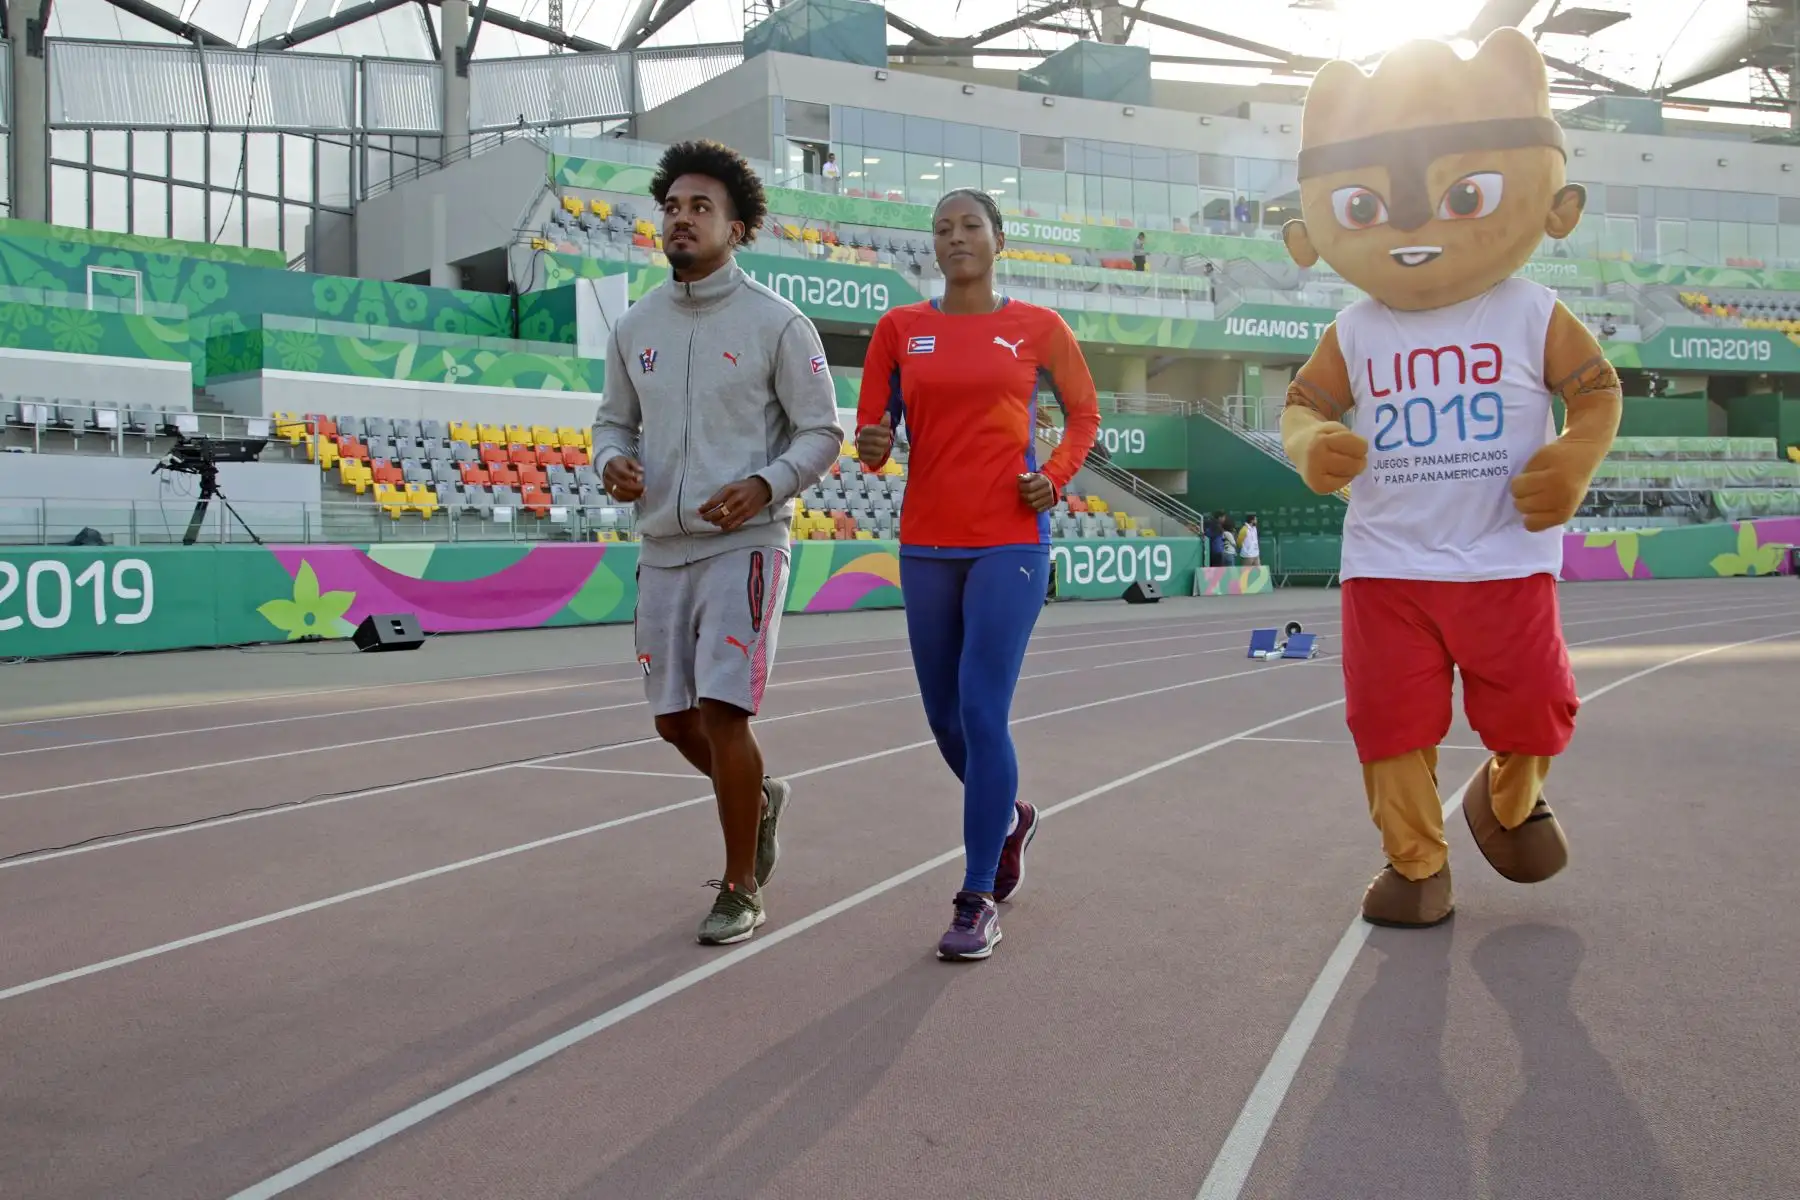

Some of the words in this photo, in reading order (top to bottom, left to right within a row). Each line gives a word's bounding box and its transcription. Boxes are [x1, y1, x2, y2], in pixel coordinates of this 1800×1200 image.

[1033, 224, 1081, 243] TODOS
[1224, 317, 1309, 340] JUGAMOS
[1312, 322, 1327, 340] T
[1374, 391, 1504, 451] 2019
[1373, 457, 1410, 471] JUEGOS
[1414, 449, 1509, 468] PANAMERICANOS
[1374, 476, 1380, 485] Y
[1384, 465, 1510, 485] PARAPANAMERICANOS
